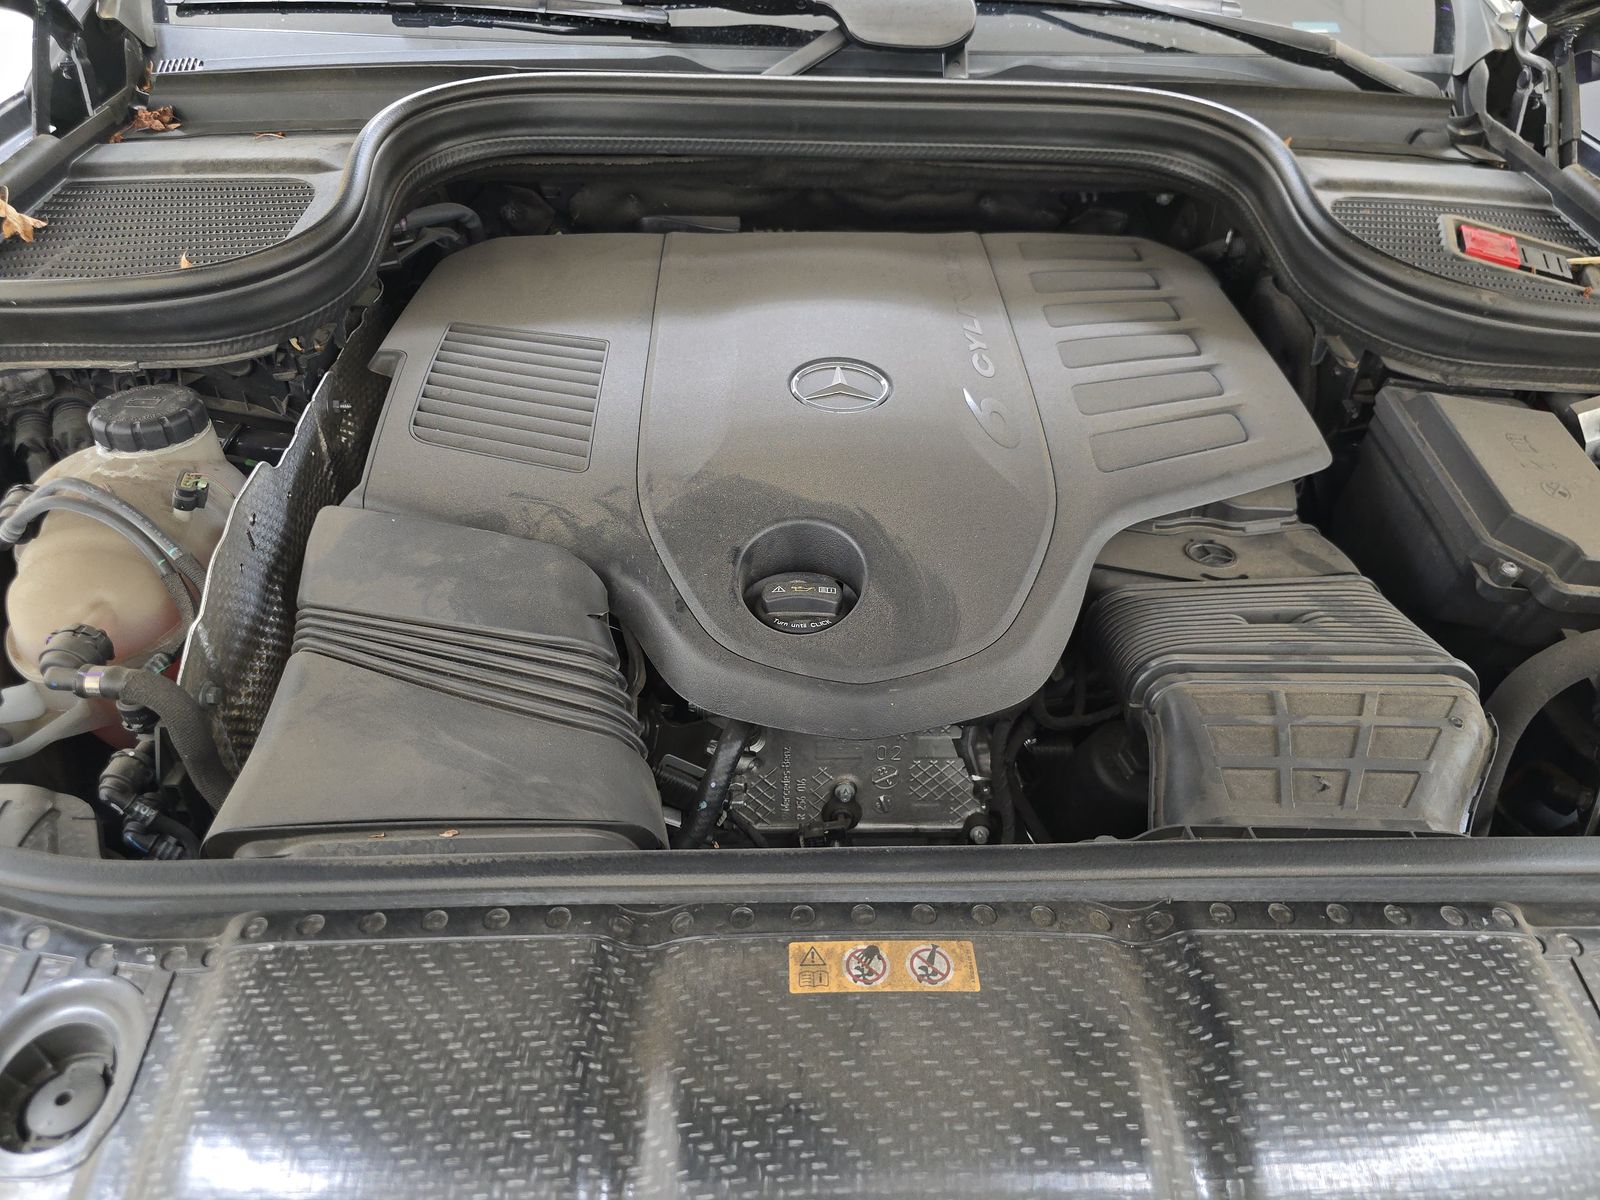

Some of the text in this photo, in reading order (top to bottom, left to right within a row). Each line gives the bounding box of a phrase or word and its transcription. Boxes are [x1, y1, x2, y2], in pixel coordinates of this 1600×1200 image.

[963, 387, 1022, 449] 6
[773, 617, 789, 627] Turn
[810, 619, 832, 628] CLICK
[876, 745, 901, 761] 02
[781, 746, 792, 812] Mercedes-Benz
